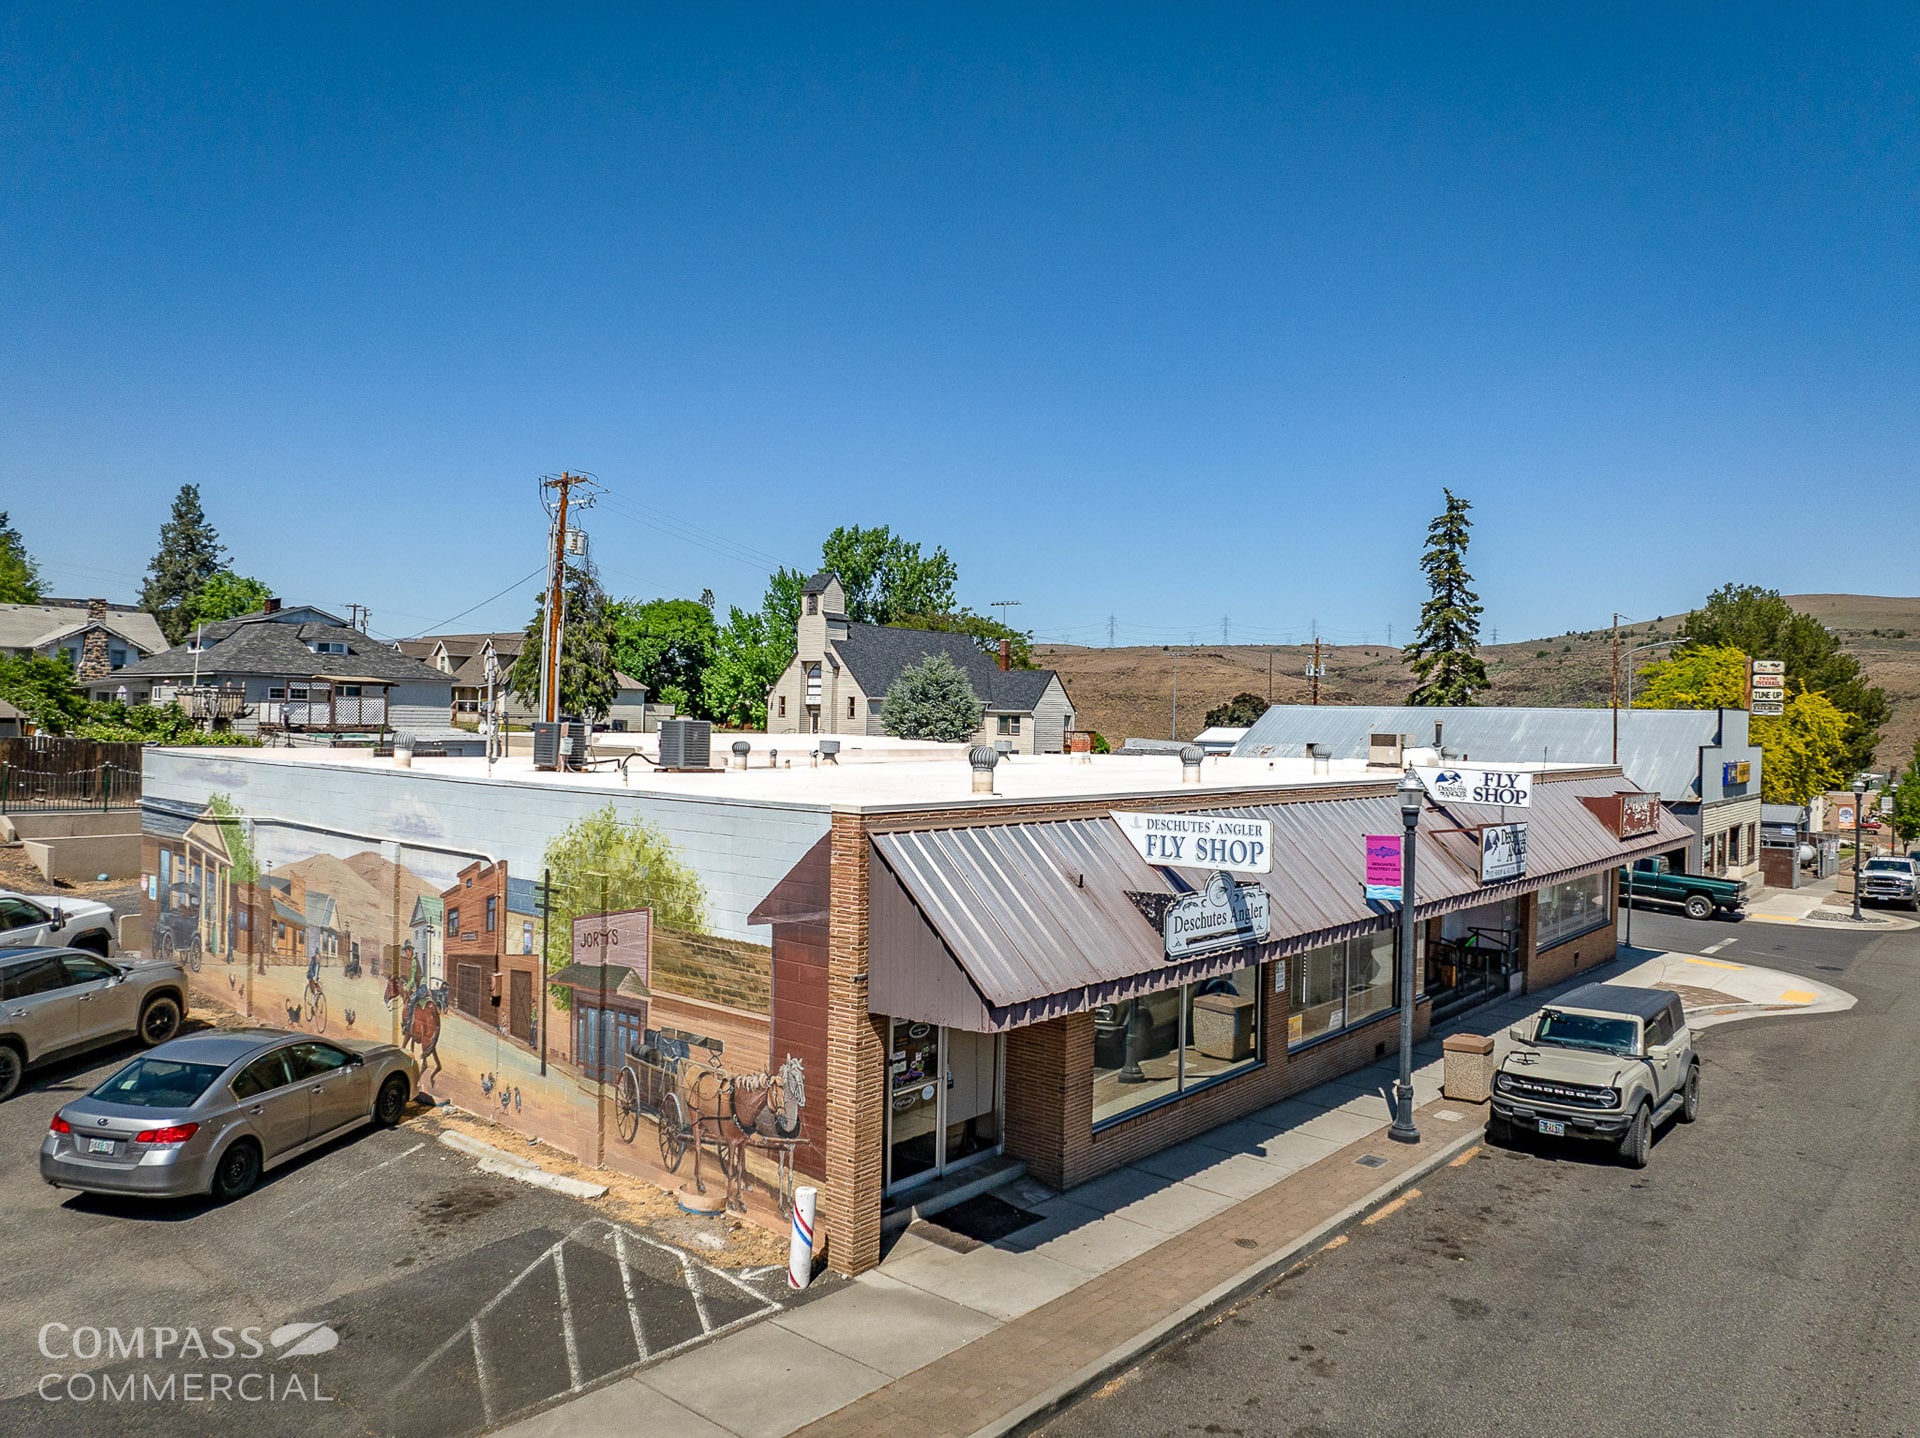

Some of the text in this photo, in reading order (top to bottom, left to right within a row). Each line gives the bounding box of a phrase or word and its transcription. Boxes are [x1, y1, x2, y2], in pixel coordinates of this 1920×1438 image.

[1773, 691, 1782, 699] UP
[1482, 772, 1520, 789] FLY
[1473, 786, 1527, 805] SHOP
[1147, 818, 1263, 837] DESCHUTES ANGLER
[1146, 833, 1264, 866] FLY SHOP
[1174, 902, 1263, 934] Deschutes Angler
[1522, 1084, 1586, 1097] BRONCO
